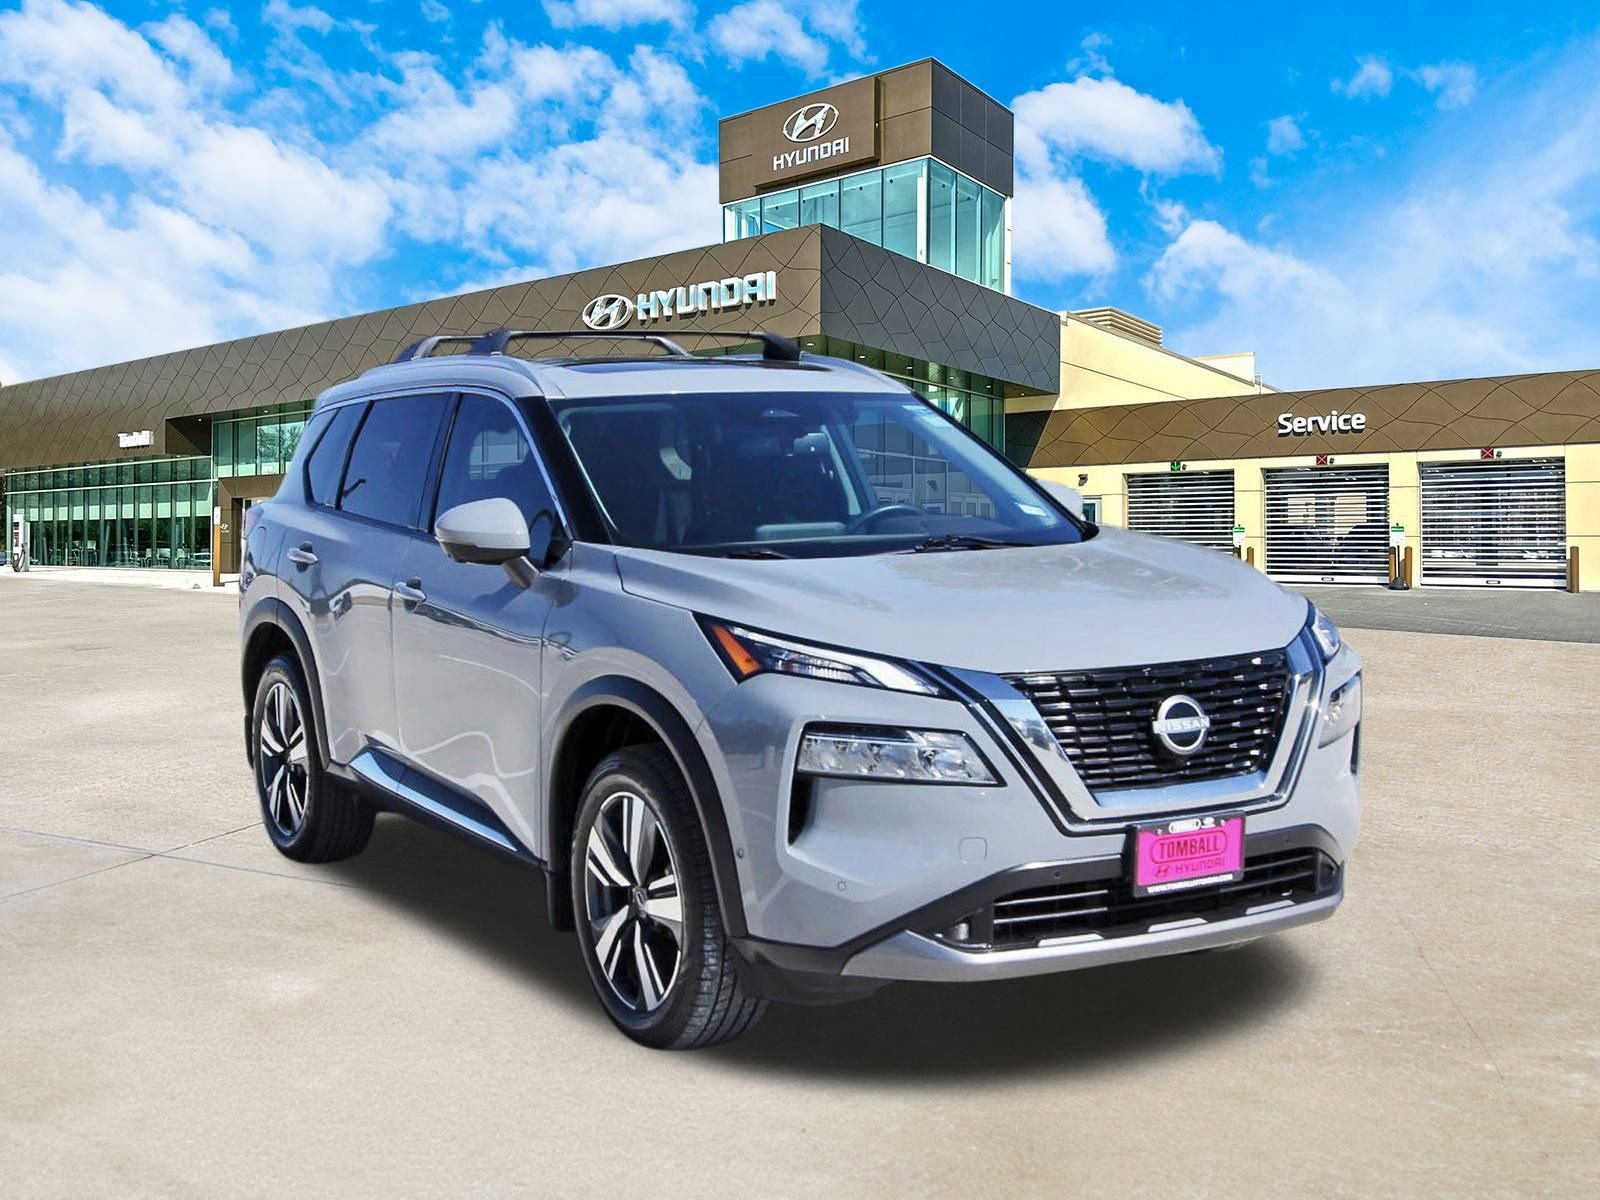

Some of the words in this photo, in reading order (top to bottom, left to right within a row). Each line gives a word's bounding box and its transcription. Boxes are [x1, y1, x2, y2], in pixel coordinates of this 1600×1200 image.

[773, 136, 849, 171] HYUNDAI
[637, 271, 777, 321] HYUNDAI
[1277, 410, 1366, 434] Service
[1159, 834, 1221, 860] TOMBALL
